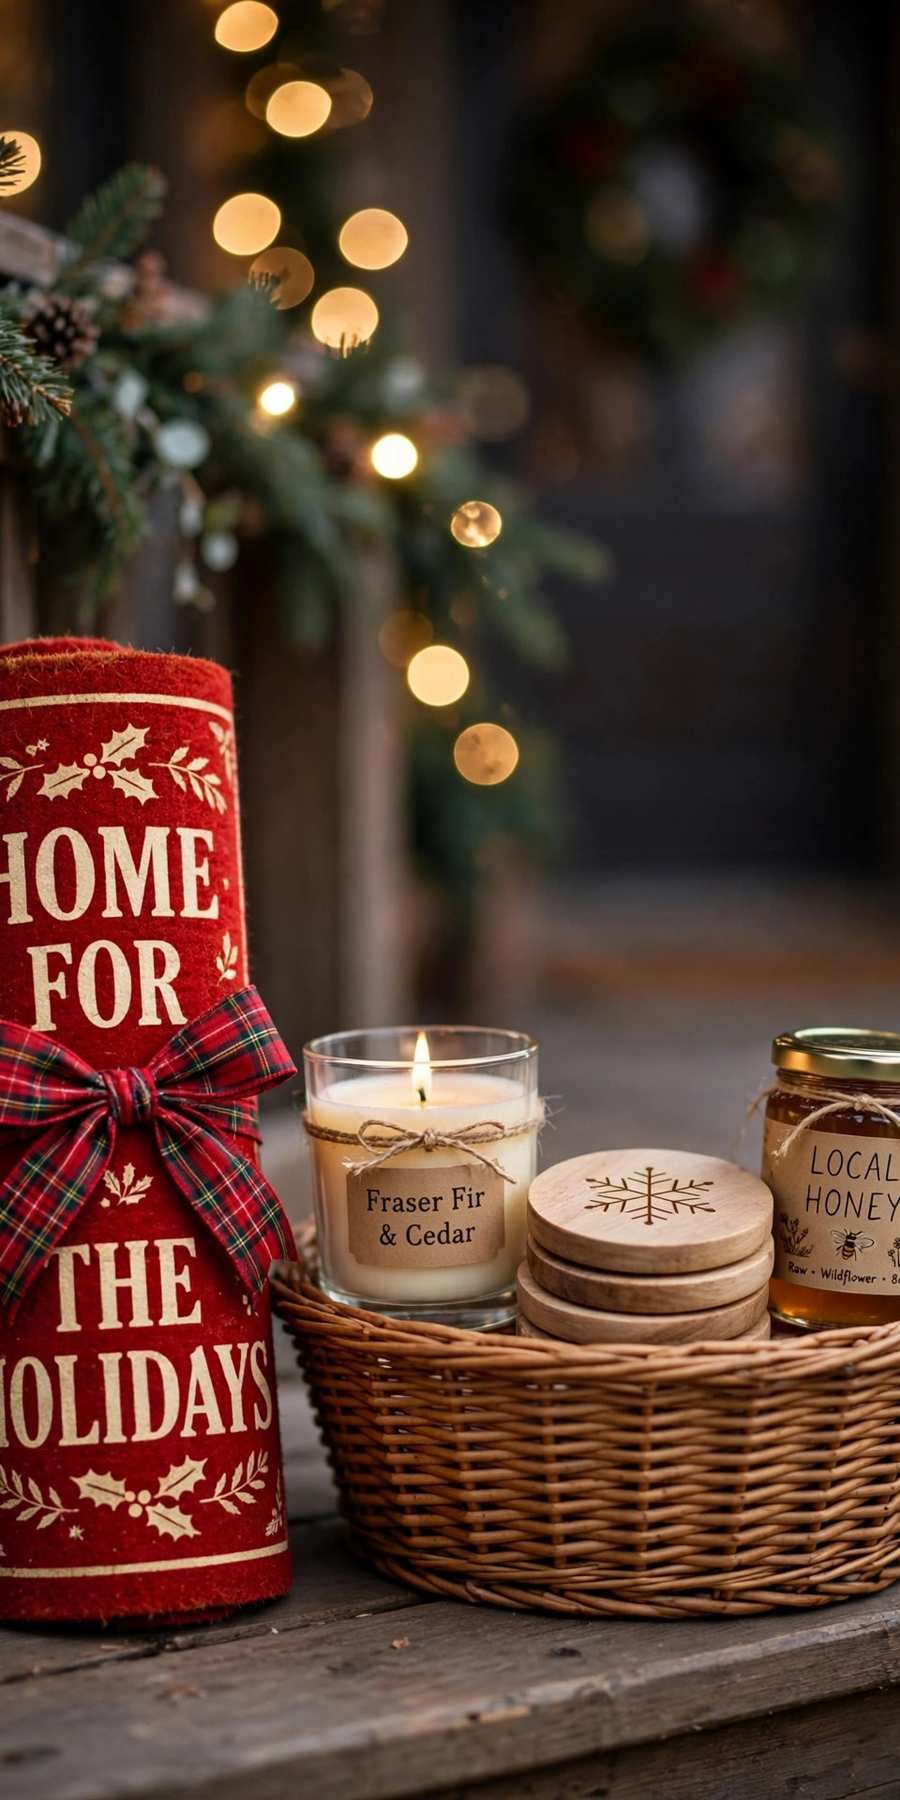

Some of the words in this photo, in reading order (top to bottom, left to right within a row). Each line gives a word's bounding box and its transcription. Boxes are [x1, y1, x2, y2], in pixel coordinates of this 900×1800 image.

[26, 939, 188, 1032] FOR
[810, 1145, 900, 1182] LOCAL
[366, 1188, 443, 1213] Fraser
[452, 1186, 485, 1210] Fir
[805, 1184, 900, 1222] HONEY
[379, 1223, 397, 1246] &
[406, 1221, 476, 1246] Cedar
[44, 1237, 202, 1333] THE
[787, 1260, 808, 1275] Raw
[820, 1267, 877, 1286] Wildflower
[0, 1340, 272, 1448] OLIDAYS
